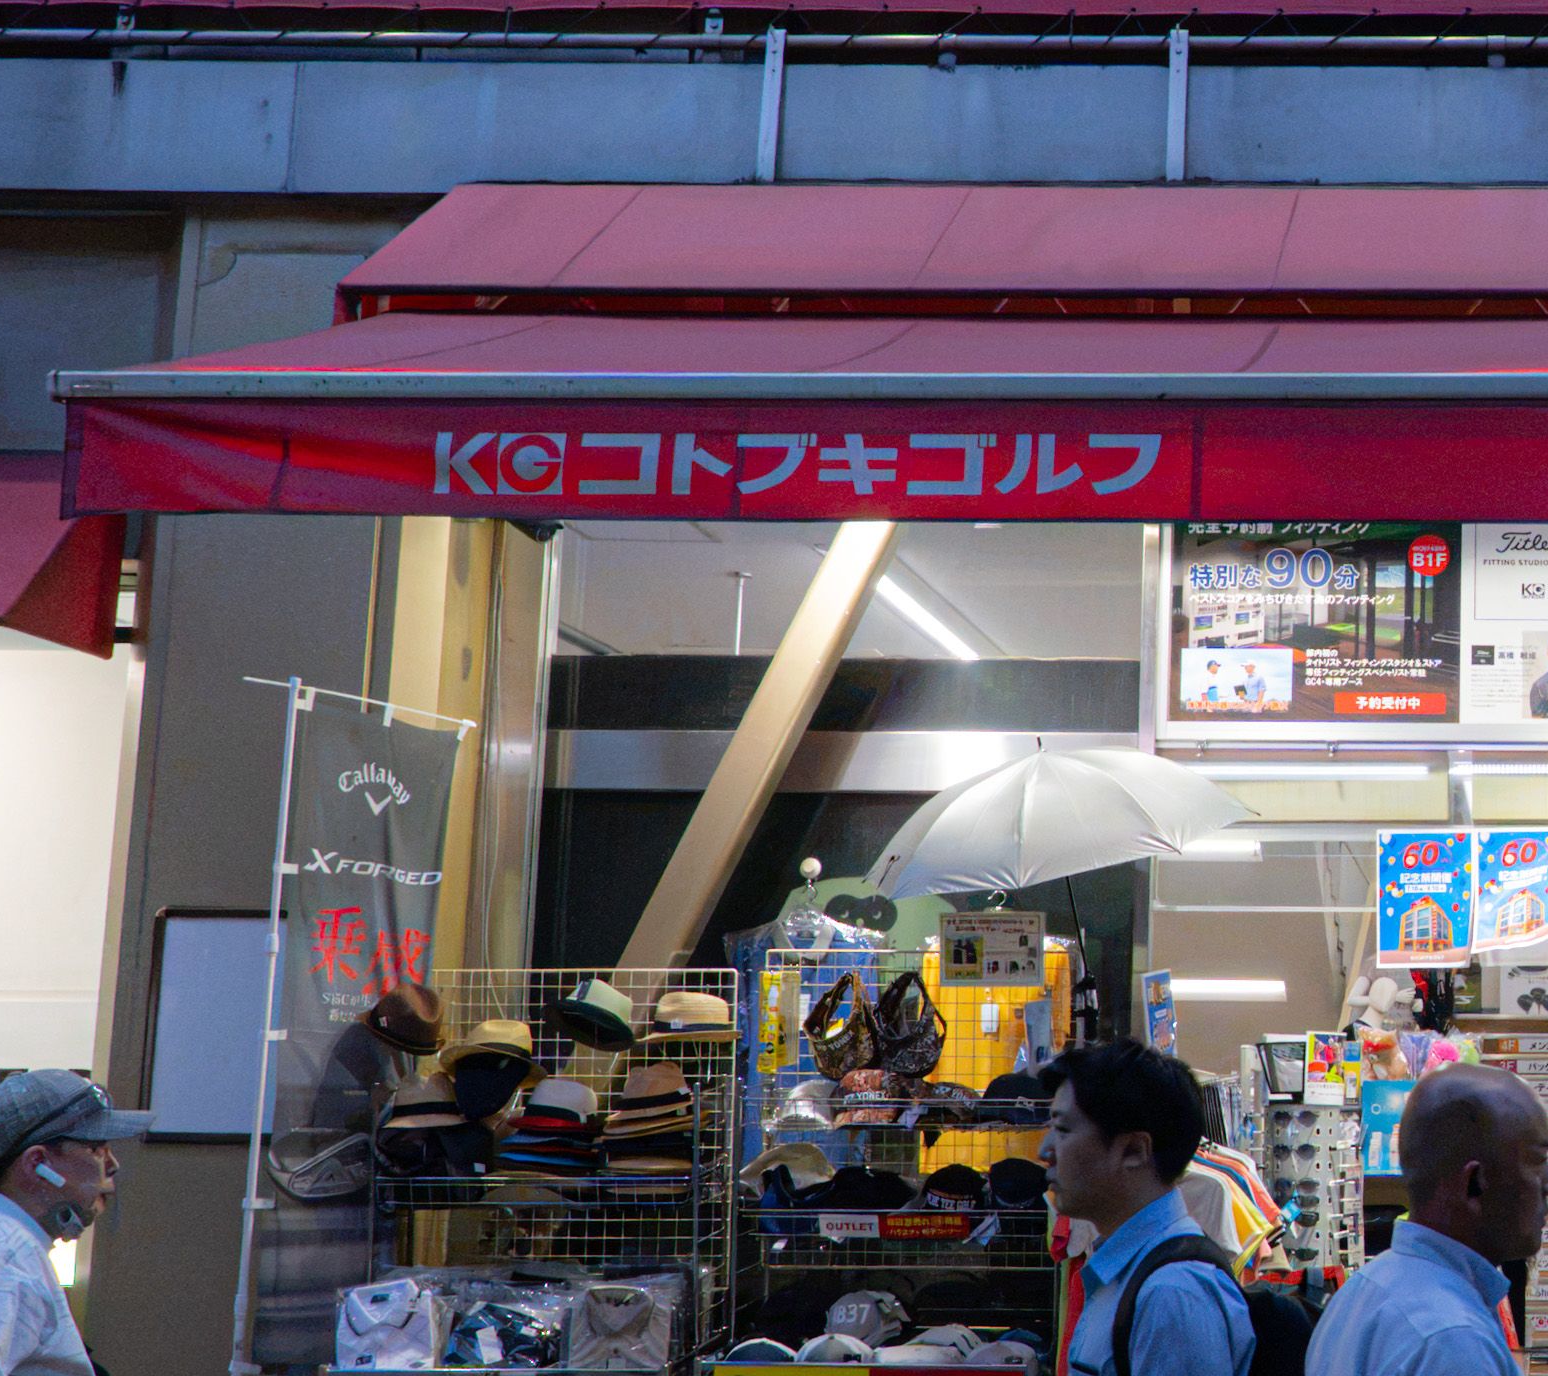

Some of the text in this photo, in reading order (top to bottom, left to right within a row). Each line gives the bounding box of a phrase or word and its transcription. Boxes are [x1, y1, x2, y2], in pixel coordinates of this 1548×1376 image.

[578, 431, 1163, 496] コトブキゴルフ
[1411, 553, 1448, 568] B1F
[1189, 547, 1360, 590] 特別な90分
[1355, 696, 1422, 710] 予約受付中
[337, 761, 412, 807] Callaway
[856, 1090, 887, 1101] YONEX
[825, 1221, 875, 1232] OUTLET
